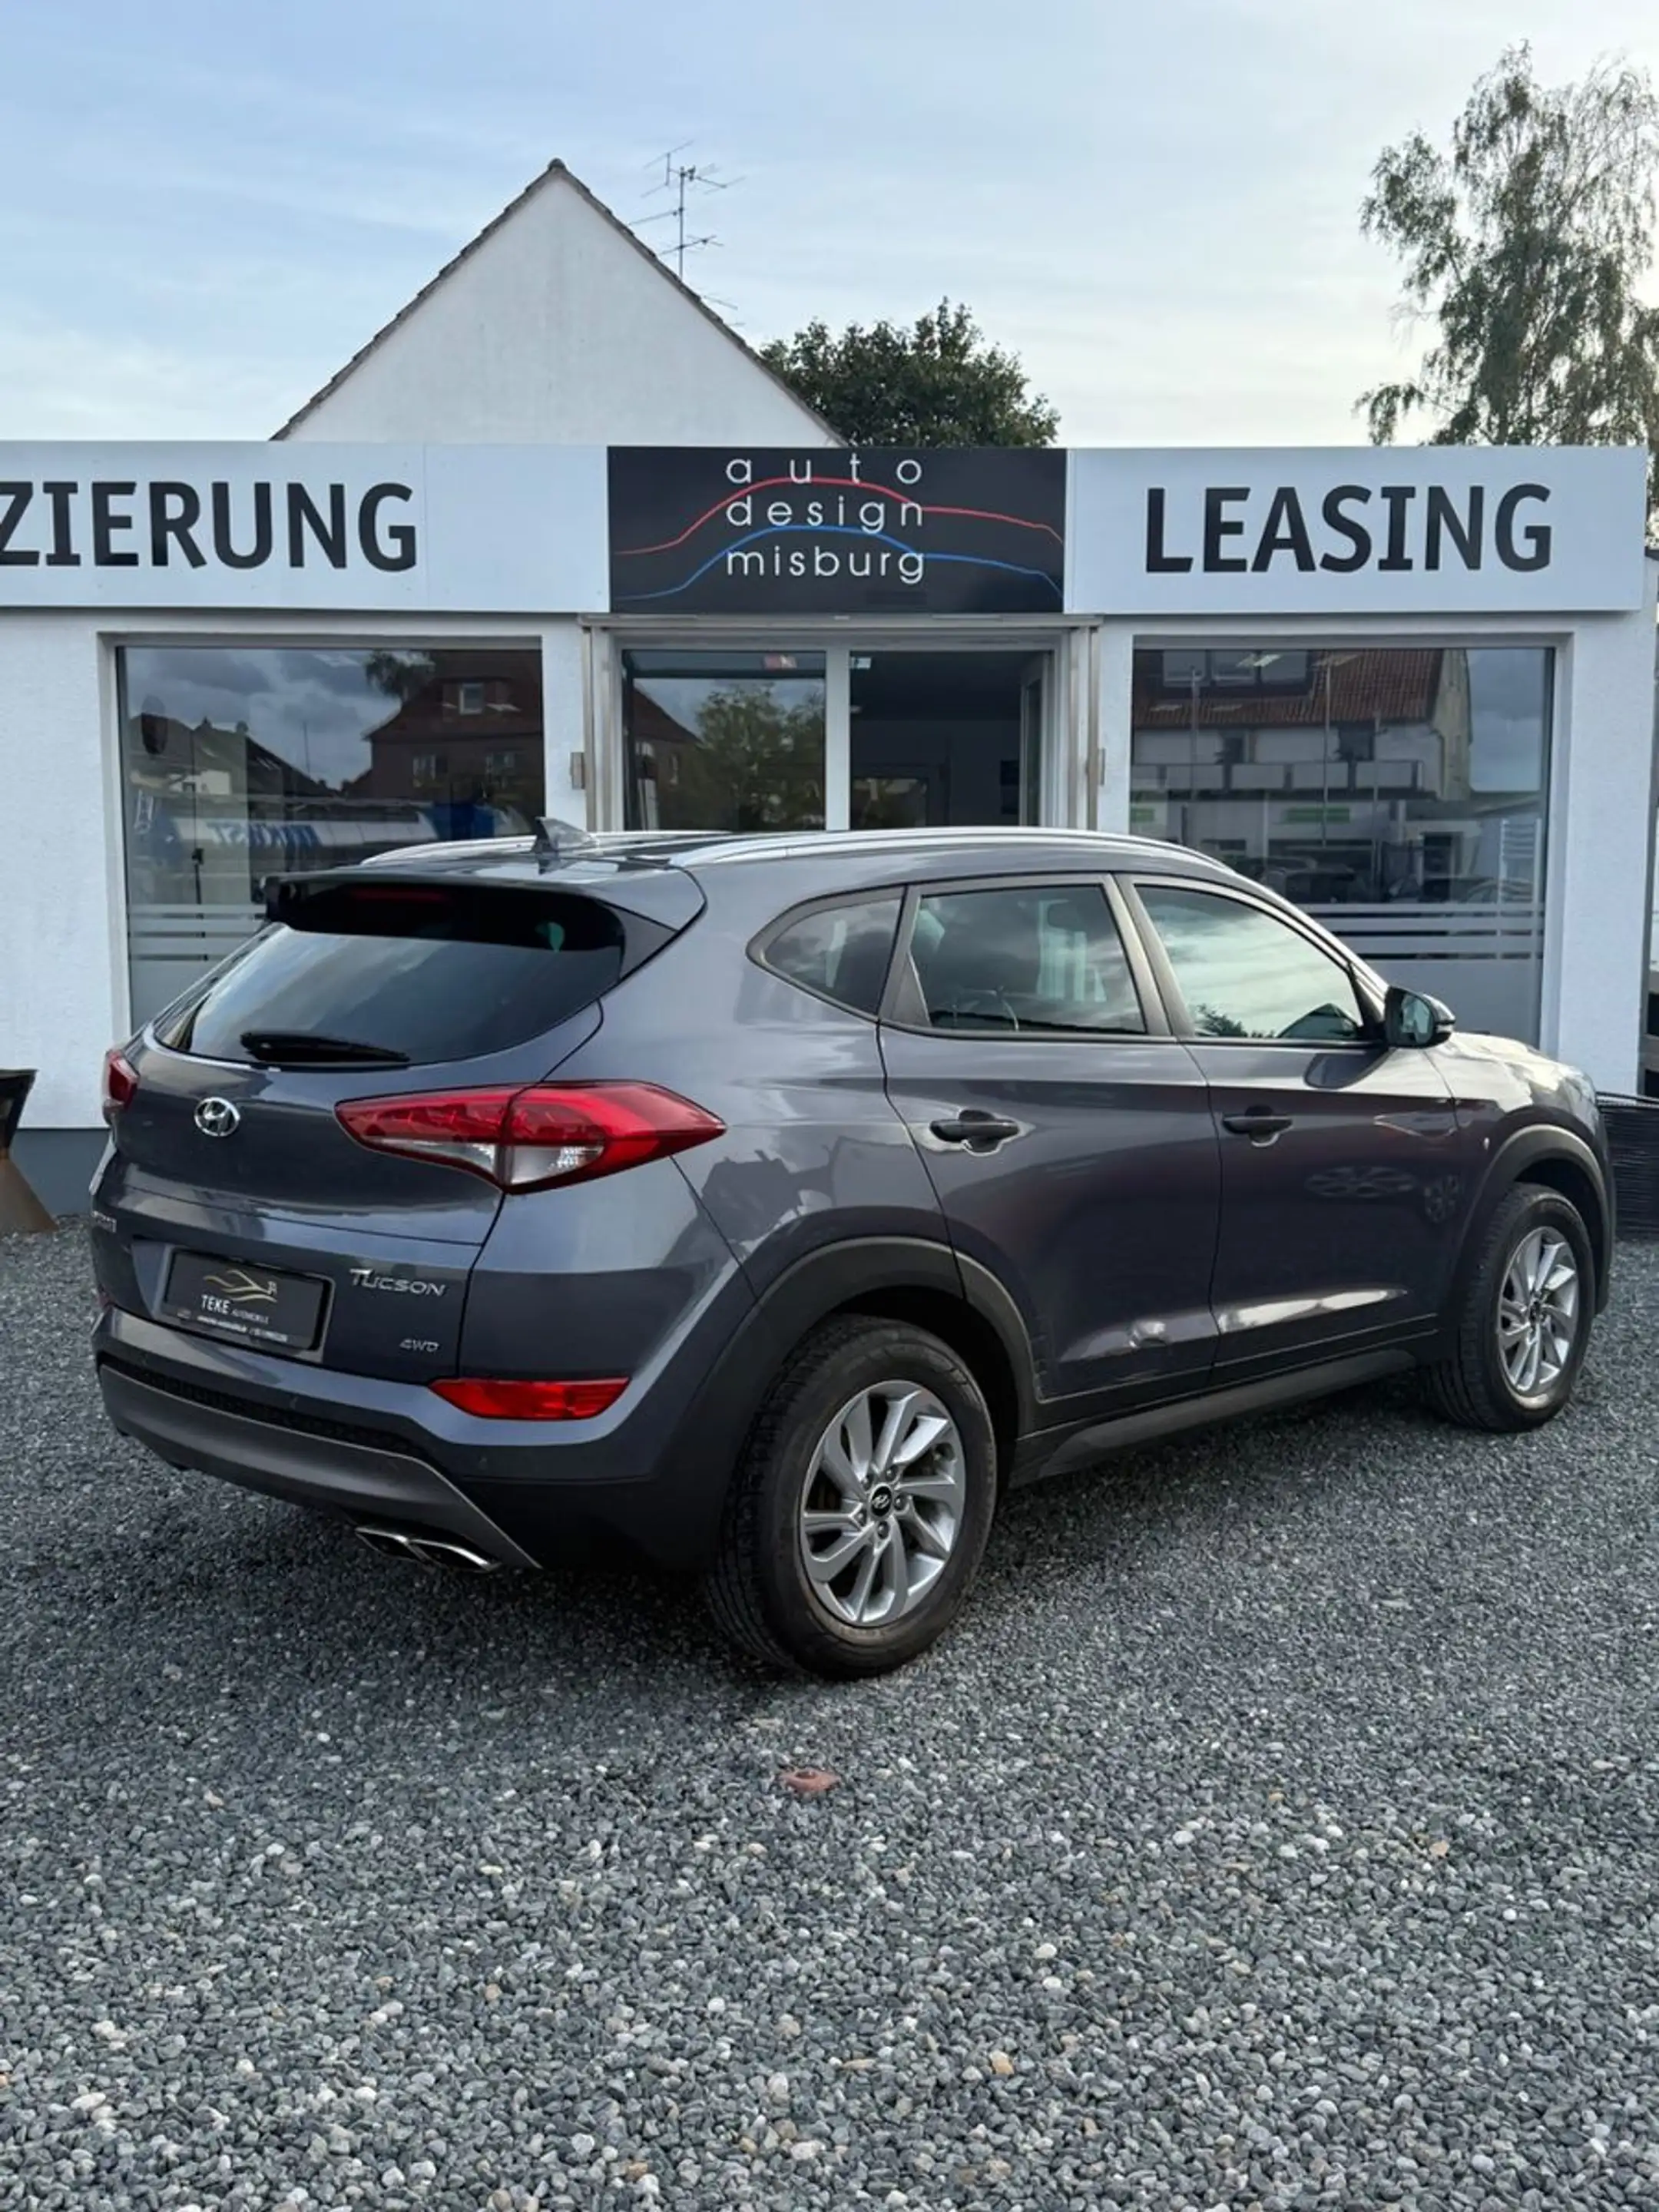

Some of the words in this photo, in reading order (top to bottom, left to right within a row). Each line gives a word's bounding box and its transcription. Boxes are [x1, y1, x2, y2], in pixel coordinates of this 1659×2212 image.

[726, 452, 922, 485] auto
[0, 481, 416, 572] ZIERUNG
[726, 495, 923, 533] design
[1145, 483, 1551, 573] LEASING
[727, 545, 925, 584] misburg
[349, 1268, 445, 1297] TUCSON
[200, 1293, 230, 1315] TEKE
[399, 1339, 439, 1353] 4WD
